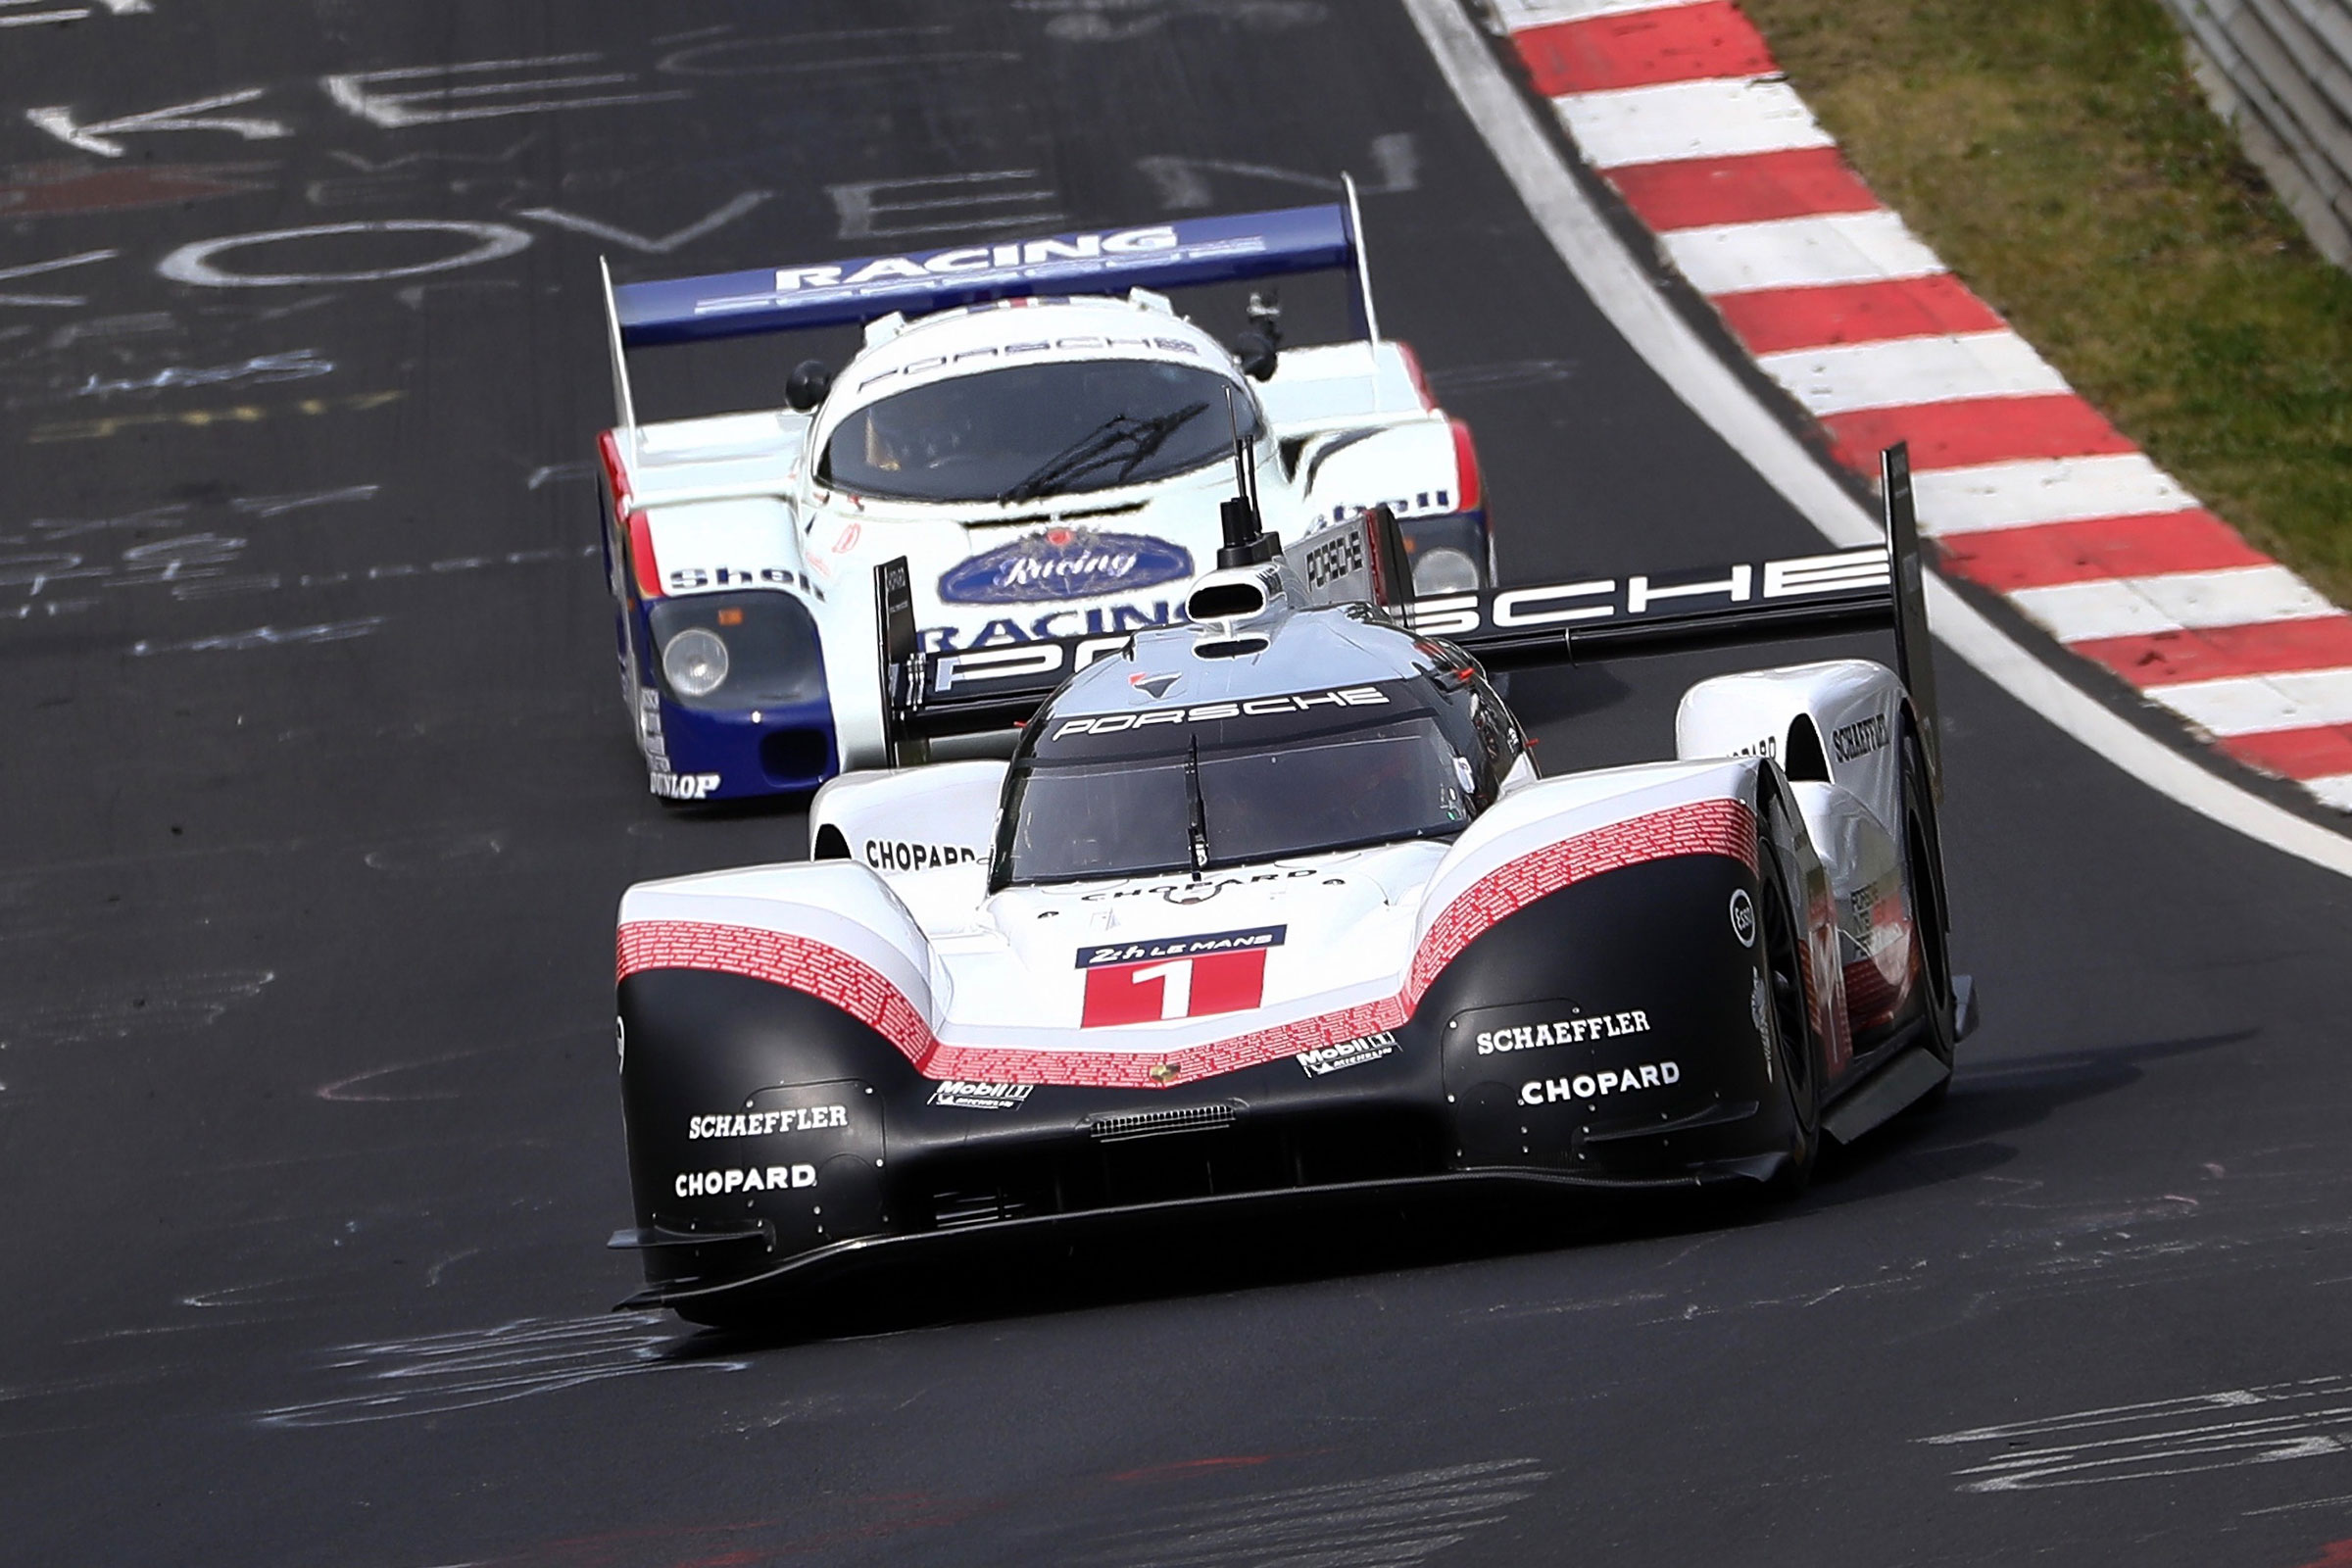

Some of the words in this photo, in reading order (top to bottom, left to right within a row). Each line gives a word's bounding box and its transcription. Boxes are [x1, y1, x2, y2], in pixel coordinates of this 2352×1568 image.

[776, 226, 1176, 291] RACING
[993, 549, 1137, 588] Racing
[1305, 530, 1363, 593] PORSCHE
[917, 601, 1192, 653] RACIN
[1052, 686, 1391, 742] PORSCHE
[650, 772, 721, 800] DUNLOP
[1190, 934, 1274, 953] MANS
[1132, 957, 1195, 1021] 1
[1296, 1034, 1370, 1067] Mobil
[1476, 1009, 1650, 1055] SCHAEFFLER
[936, 1080, 1009, 1098] Mobil
[1521, 1060, 1681, 1105] CHOPARD
[688, 1104, 849, 1140] SCHAEFFLER
[674, 1163, 817, 1198] CHOPARD
